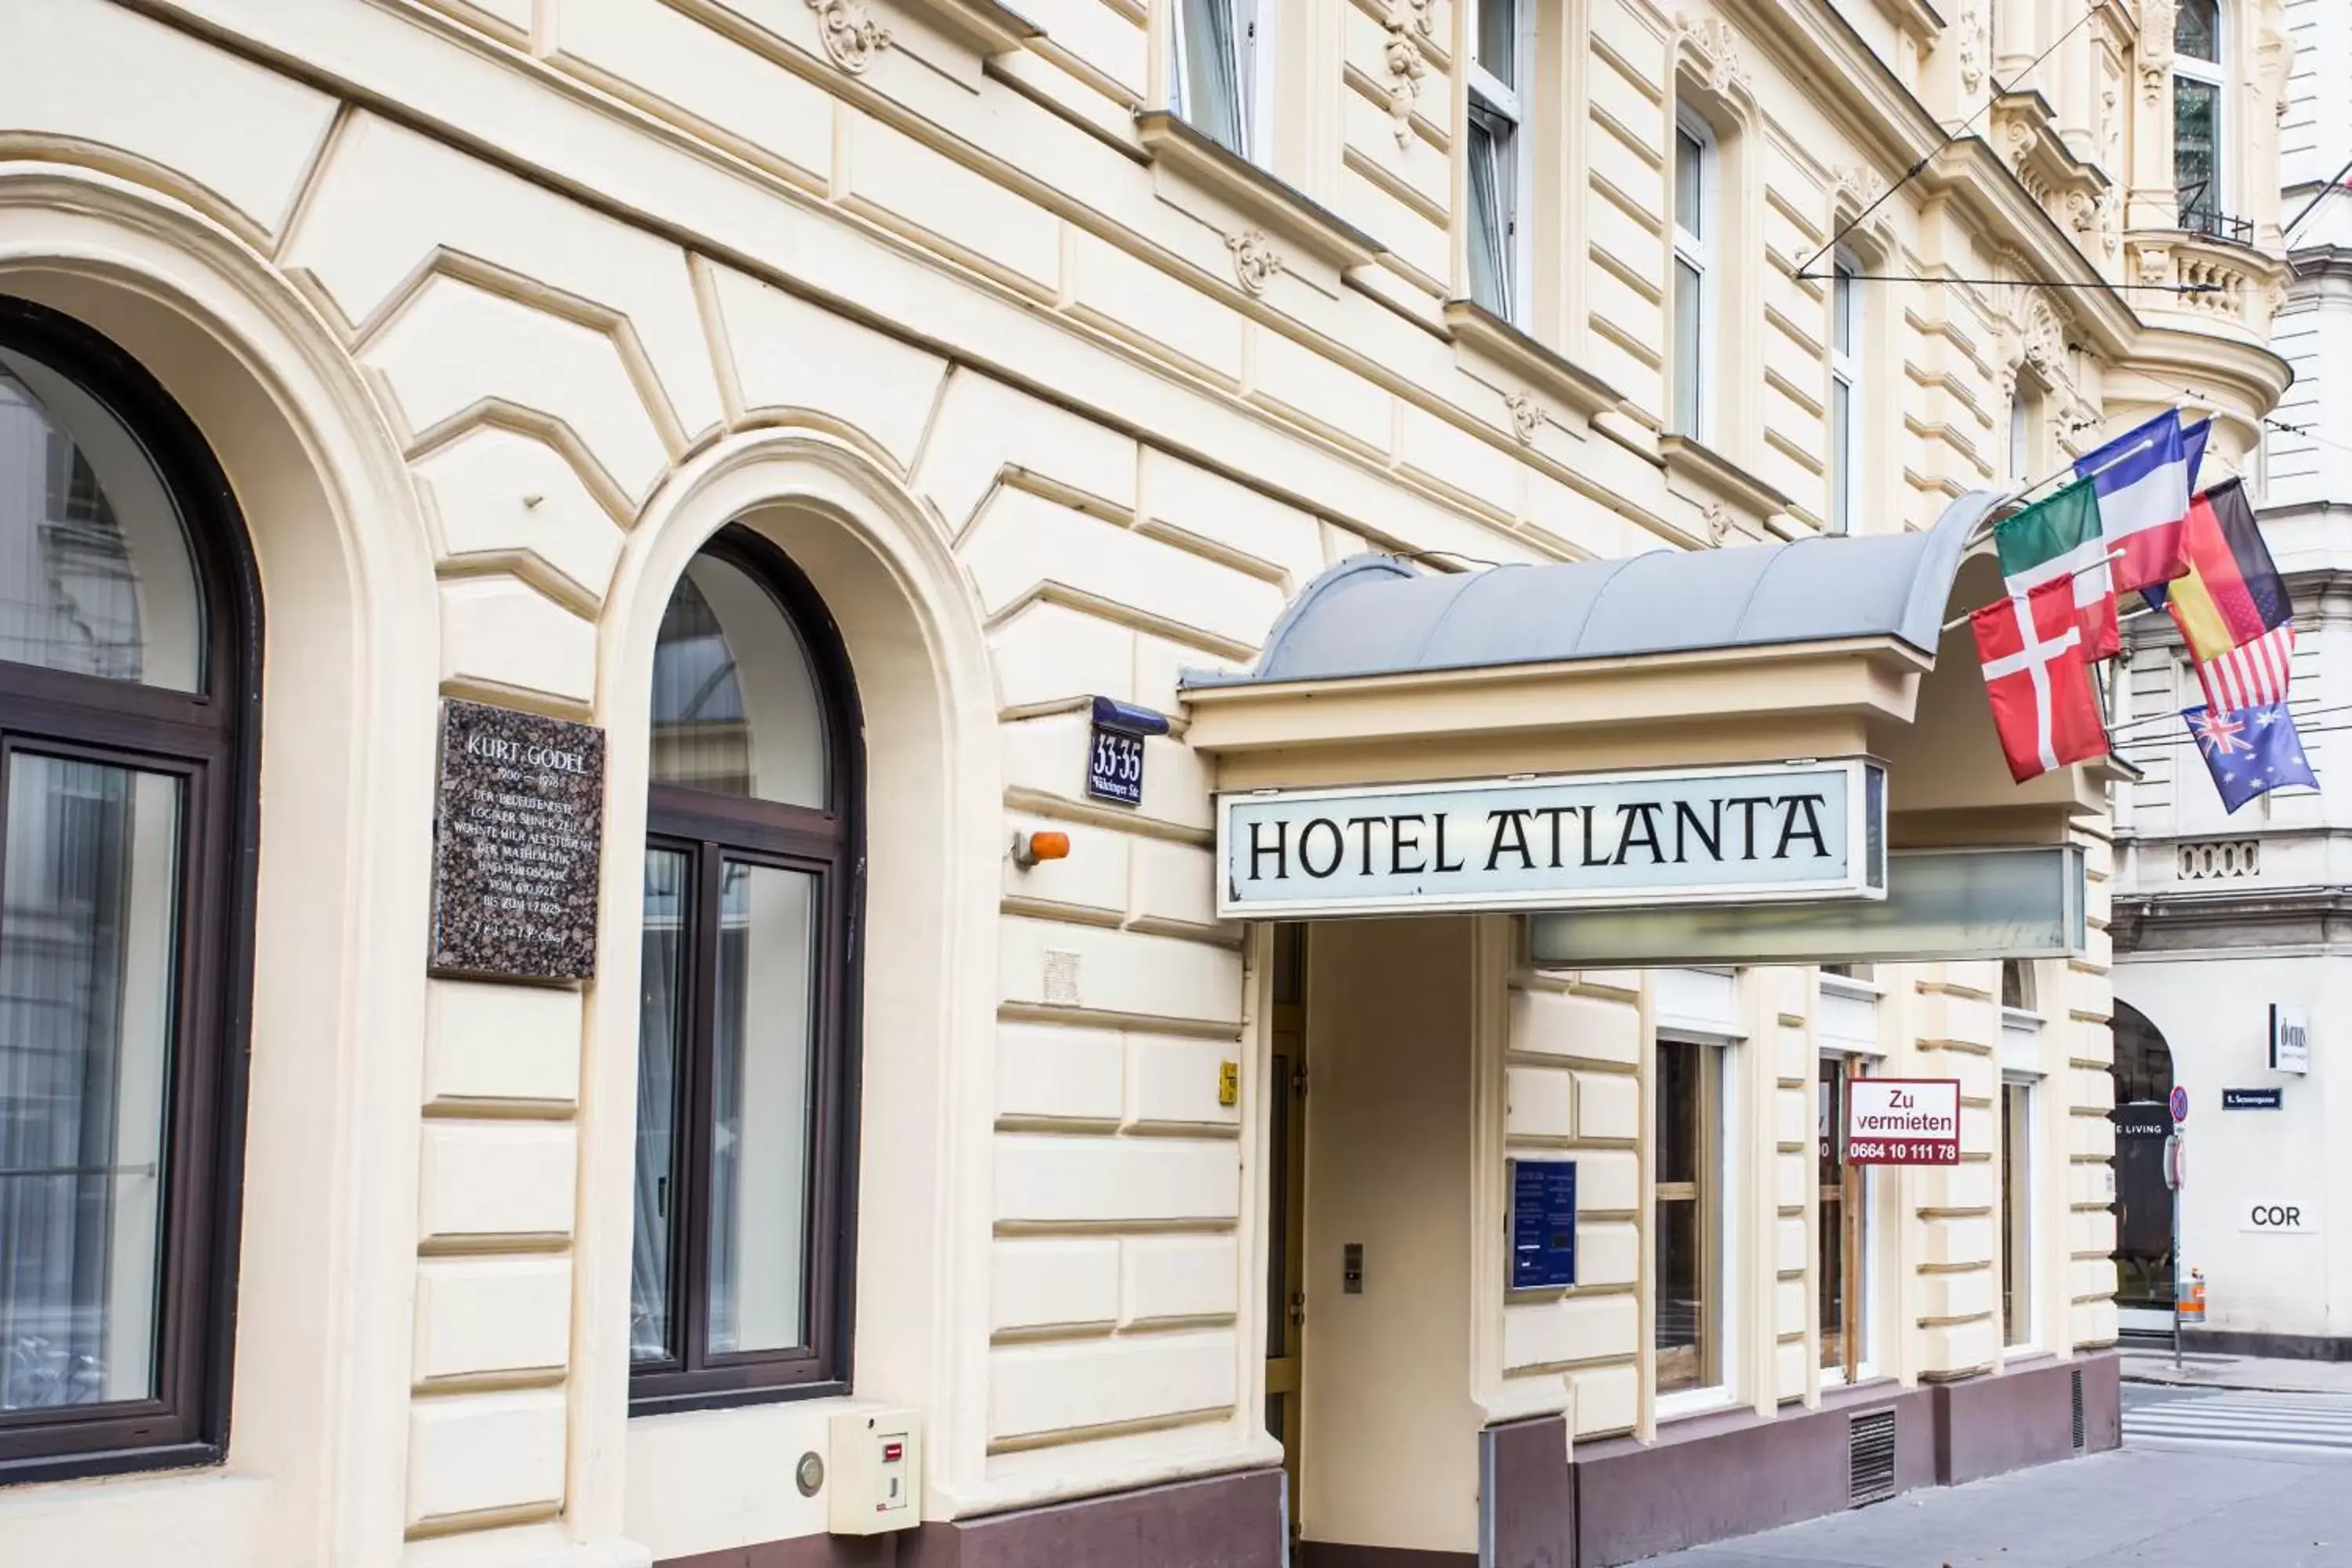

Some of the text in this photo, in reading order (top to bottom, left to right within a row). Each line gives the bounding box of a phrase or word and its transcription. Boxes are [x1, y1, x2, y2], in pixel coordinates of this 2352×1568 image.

[468, 734, 588, 775] KURT GÖDEL
[473, 789, 494, 802] DER
[528, 833, 546, 844] ALS
[1247, 793, 1831, 880] HOTEL ATLANTA
[1889, 1090, 1914, 1108] Zu
[1857, 1112, 1951, 1131] vermieten
[2125, 1125, 2161, 1134] LIVING
[1850, 1142, 1956, 1160] 0664 10 111 78
[2251, 1205, 2301, 1226] COR
